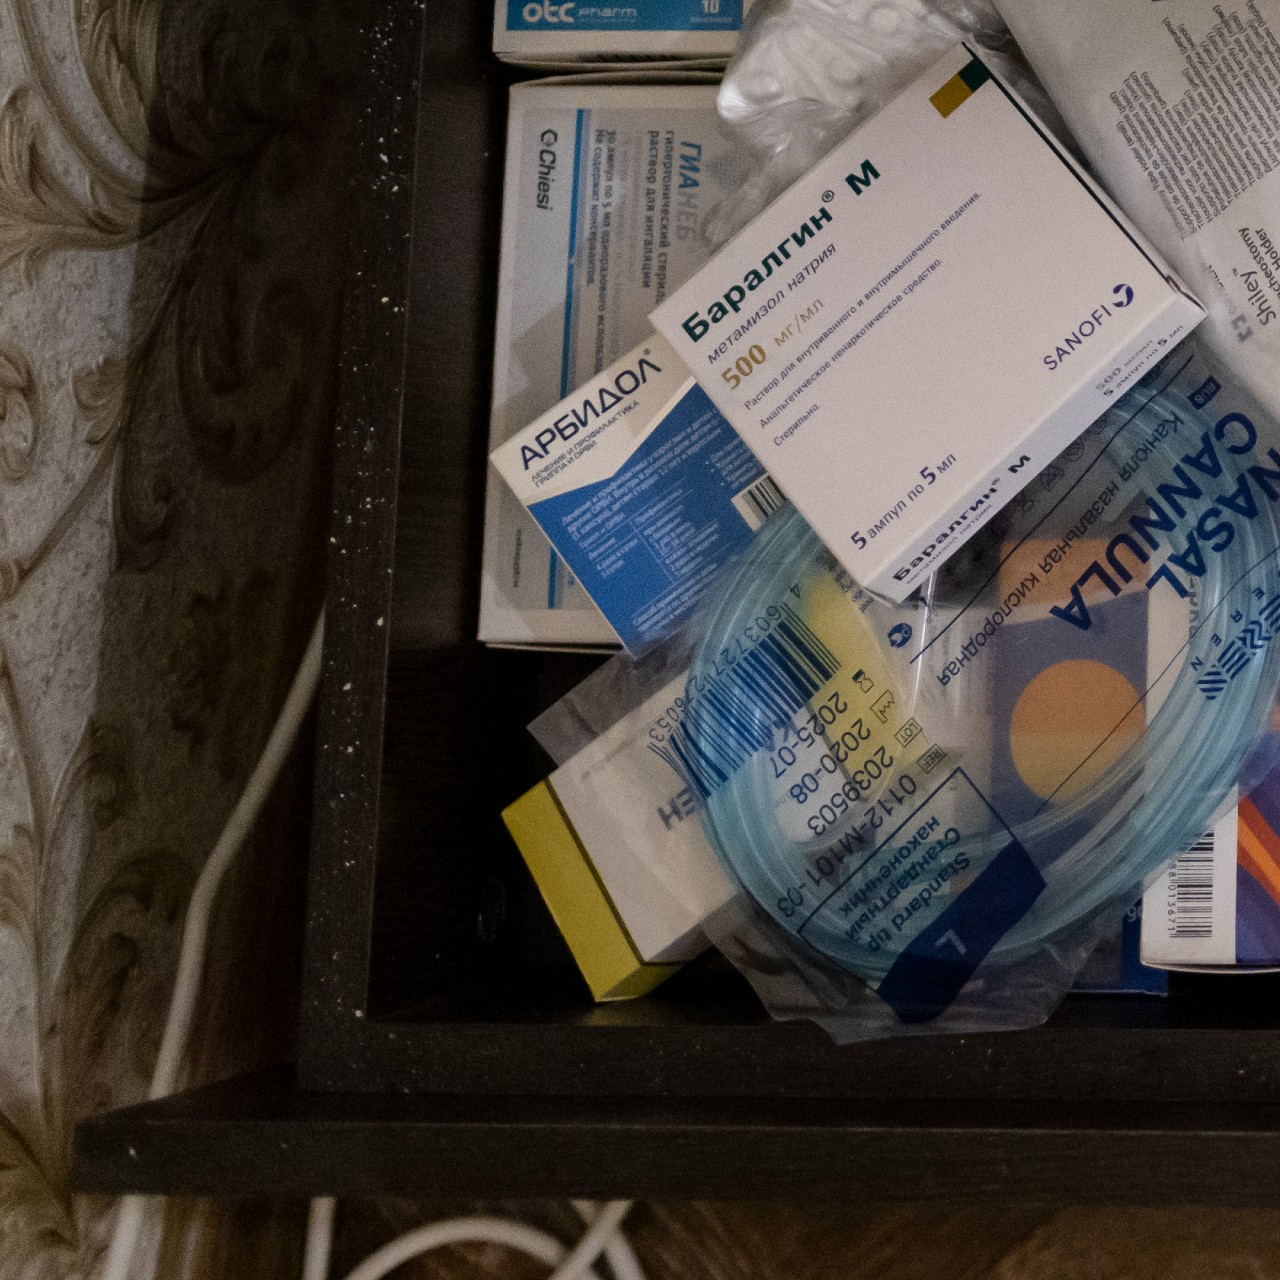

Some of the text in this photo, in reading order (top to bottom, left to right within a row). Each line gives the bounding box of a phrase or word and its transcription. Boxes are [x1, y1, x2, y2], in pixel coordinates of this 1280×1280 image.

[535, 148, 556, 211] Chiesi
[639, 130, 660, 288] раствор для ингаляции
[656, 130, 674, 248] гипертонический
[703, 240, 839, 365] метамизол натрия
[719, 293, 828, 391] 500 мг/мл
[742, 188, 984, 411] Раствор для внутривенного внутримышечного введения.
[756, 254, 945, 429] Анальгетическое ненаркотическое средство.
[1039, 302, 1113, 372] SANOFI
[512, 352, 663, 469] АРБИДОЛ
[572, 398, 640, 450] ПРОФИЛАКТИКА
[771, 399, 823, 448] Стерильно.
[534, 460, 568, 488] ГРИППА
[850, 449, 958, 550] 5 ампул по 5 мл
[1047, 405, 1264, 640] CANNULA
[932, 409, 1185, 691] Канюля назальная кислородная
[762, 689, 850, 779] 2025-07
[786, 717, 874, 806] 2020-08
[803, 744, 895, 839] 2039503
[774, 771, 920, 920] 0112-M101-03
[836, 814, 942, 920] наконечник
[841, 821, 964, 946] Стандартный
[864, 848, 972, 956] Standard tip
